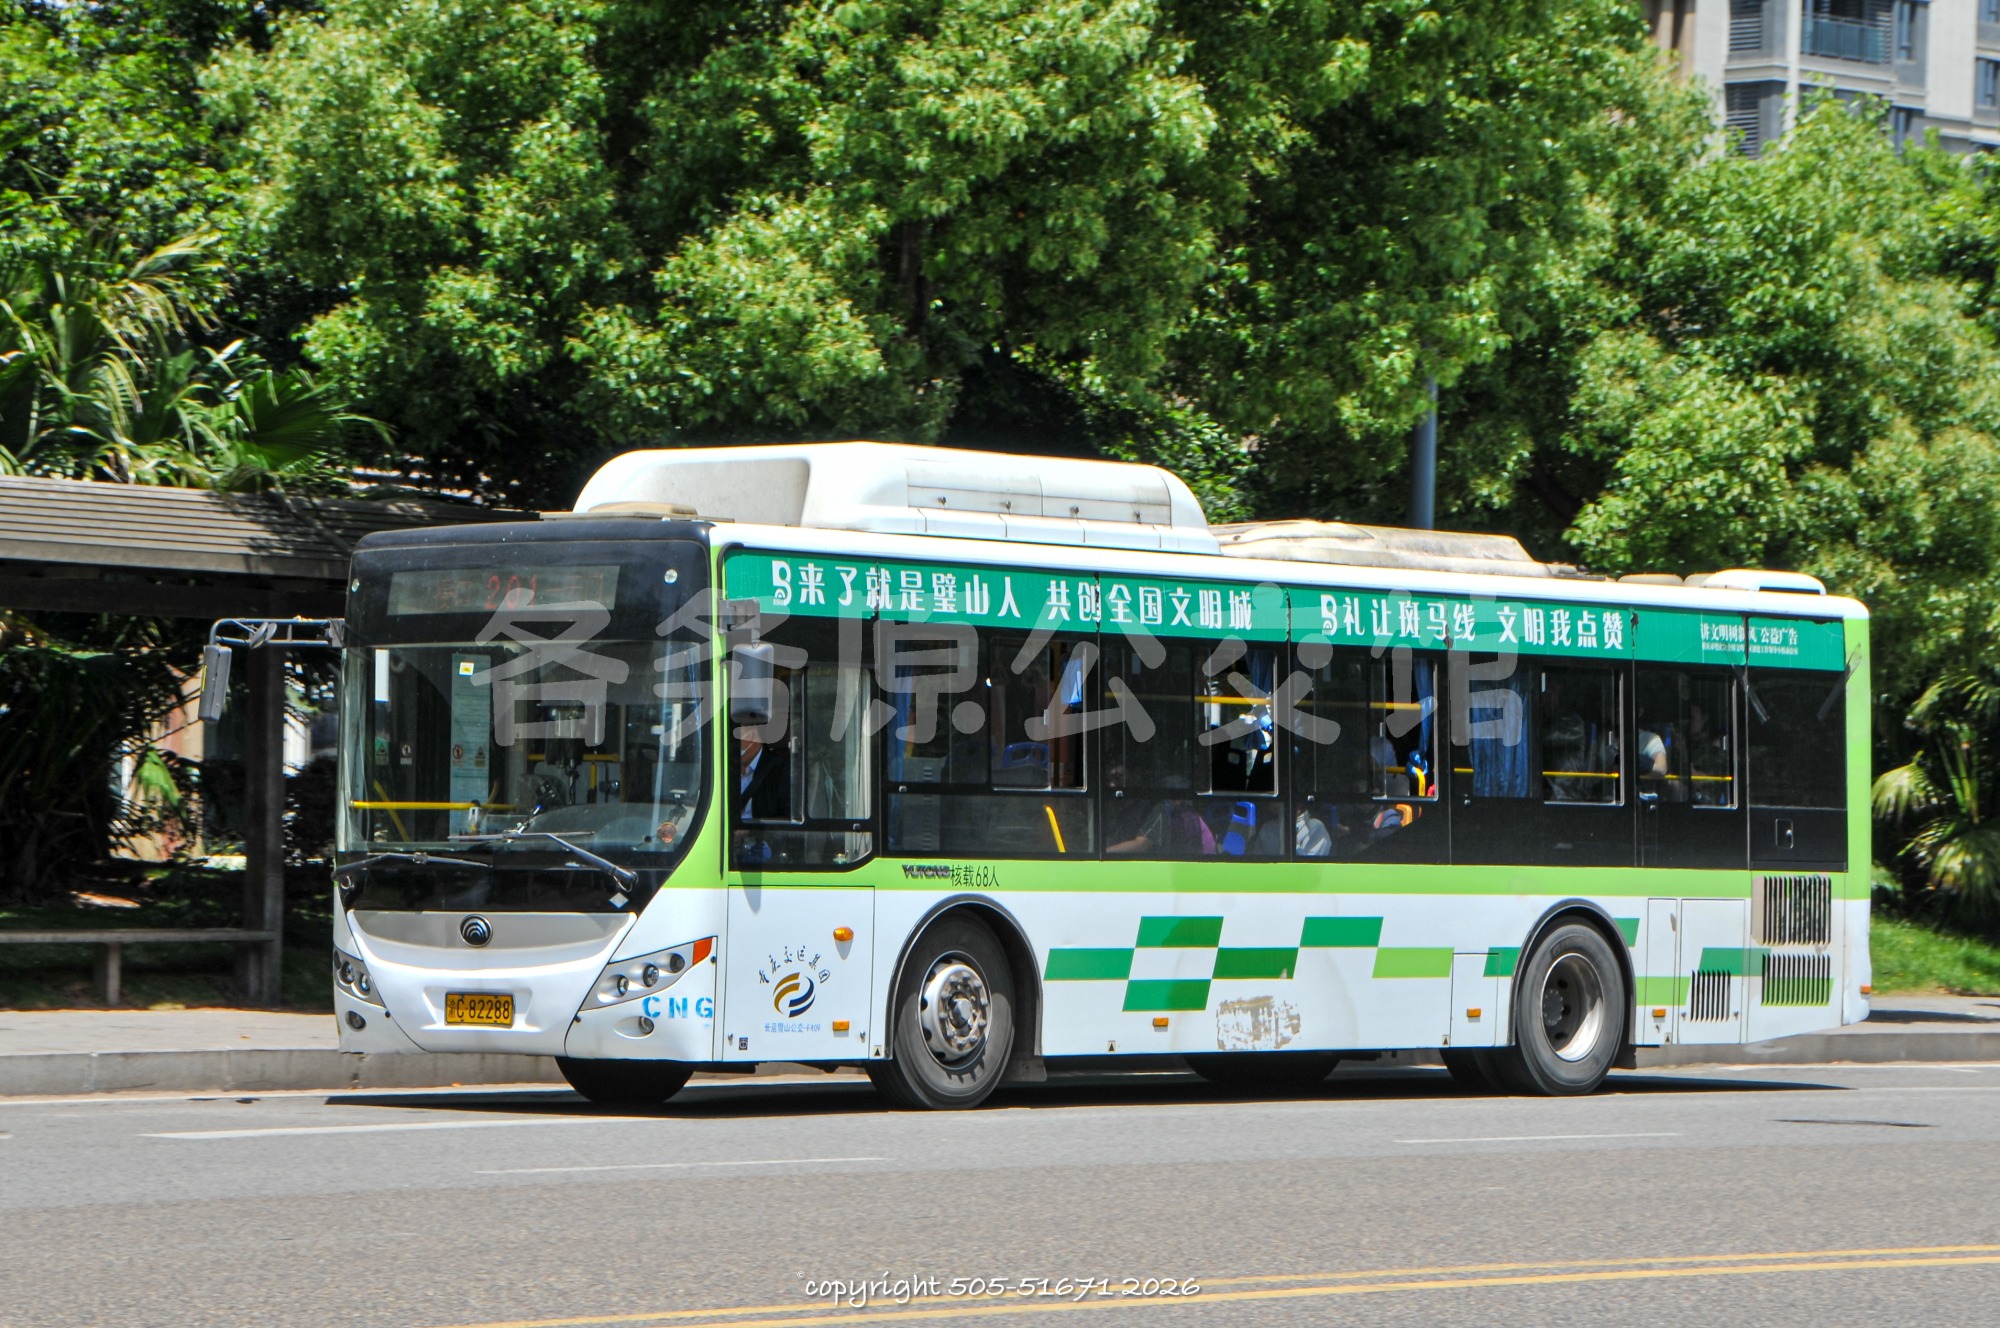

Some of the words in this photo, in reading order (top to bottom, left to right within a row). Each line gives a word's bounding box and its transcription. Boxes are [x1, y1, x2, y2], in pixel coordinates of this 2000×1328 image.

[484, 574, 538, 610] 201
[798, 562, 1021, 618] 来了就是璧山人
[1047, 579, 1253, 630] 共创全国文明城
[1343, 596, 1476, 641] 礼让斑马线
[1497, 605, 1624, 650] 文明我点赞
[950, 864, 1000, 887] 核载68人
[642, 996, 713, 1019] CNG
